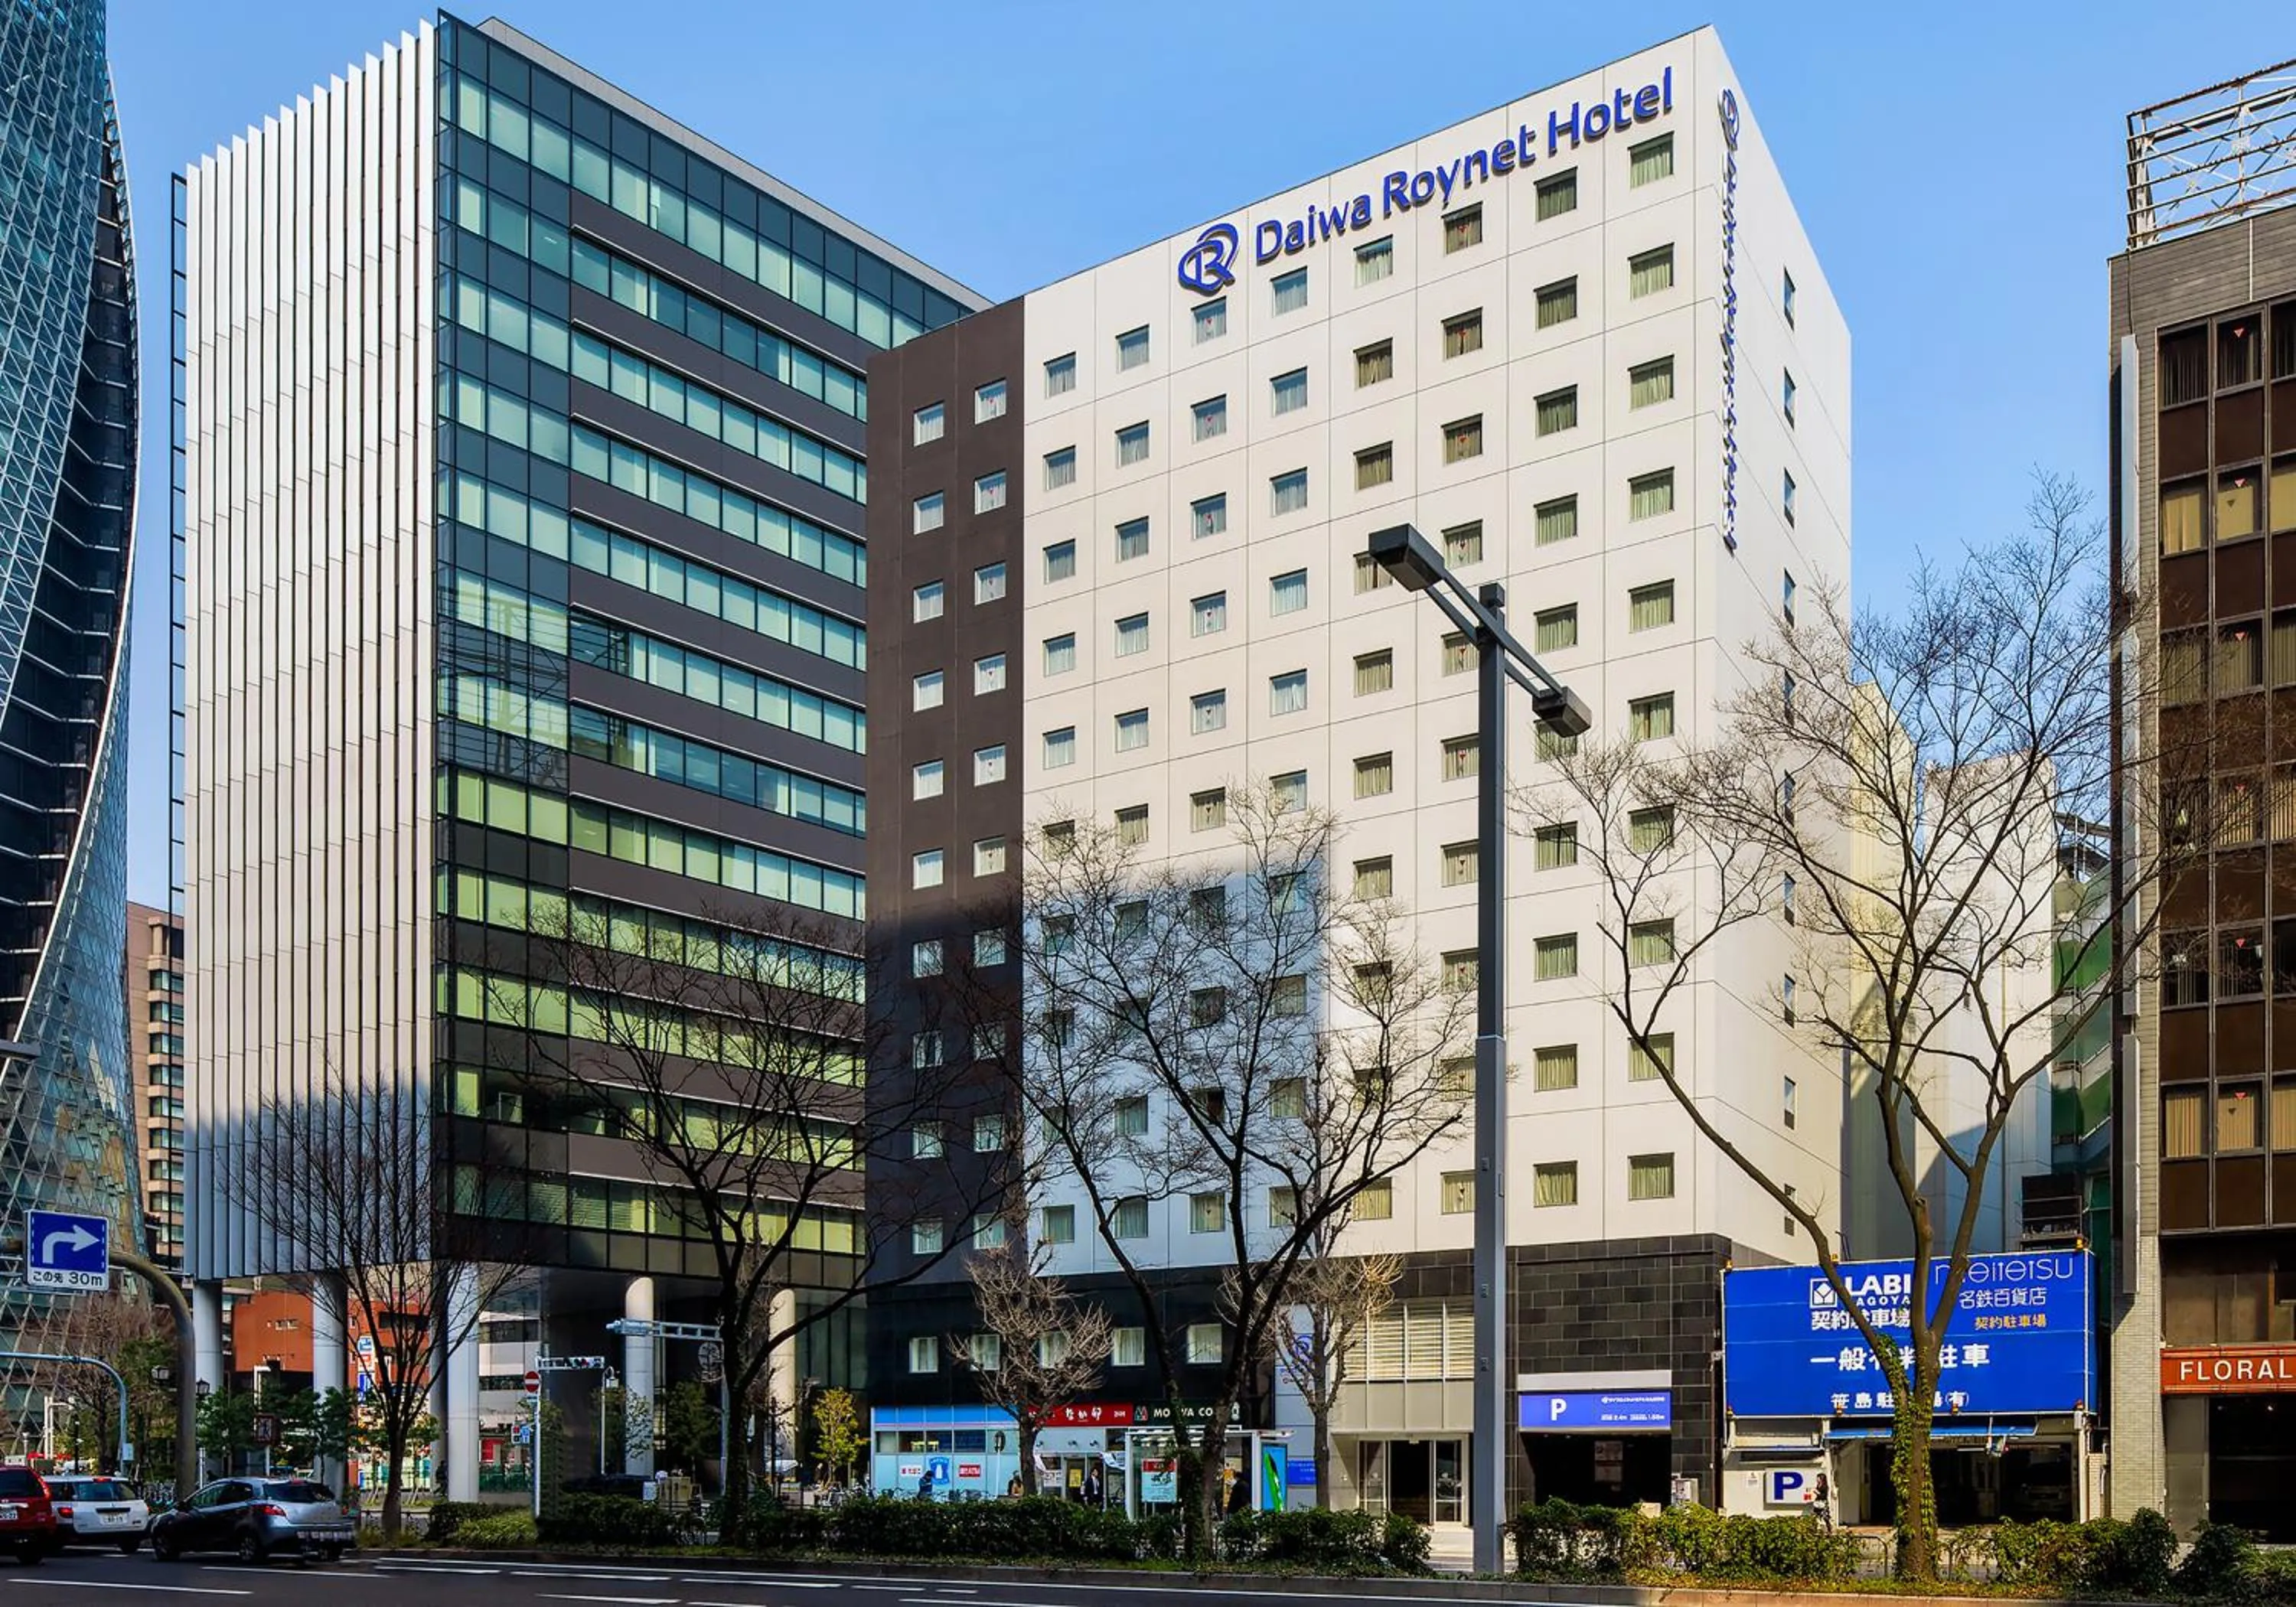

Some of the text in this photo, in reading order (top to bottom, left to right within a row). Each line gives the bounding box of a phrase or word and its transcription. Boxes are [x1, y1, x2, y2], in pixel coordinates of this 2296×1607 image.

[1256, 194, 1371, 265] Daiwa
[1382, 124, 1536, 218] Roynet
[1548, 65, 1673, 158] Hotel
[33, 1271, 103, 1286] この先 30m
[1845, 1273, 1911, 1296] LABI
[1855, 1296, 1911, 1306] AGOYA
[1959, 1287, 2047, 1309] 名鉄百貨店
[1975, 1313, 2047, 1331] 契約駐車場
[2180, 1359, 2293, 1380] FLORAL
[1153, 1407, 1195, 1418] MOVA
[1551, 1398, 1567, 1421] P
[1773, 1472, 1803, 1501] P
